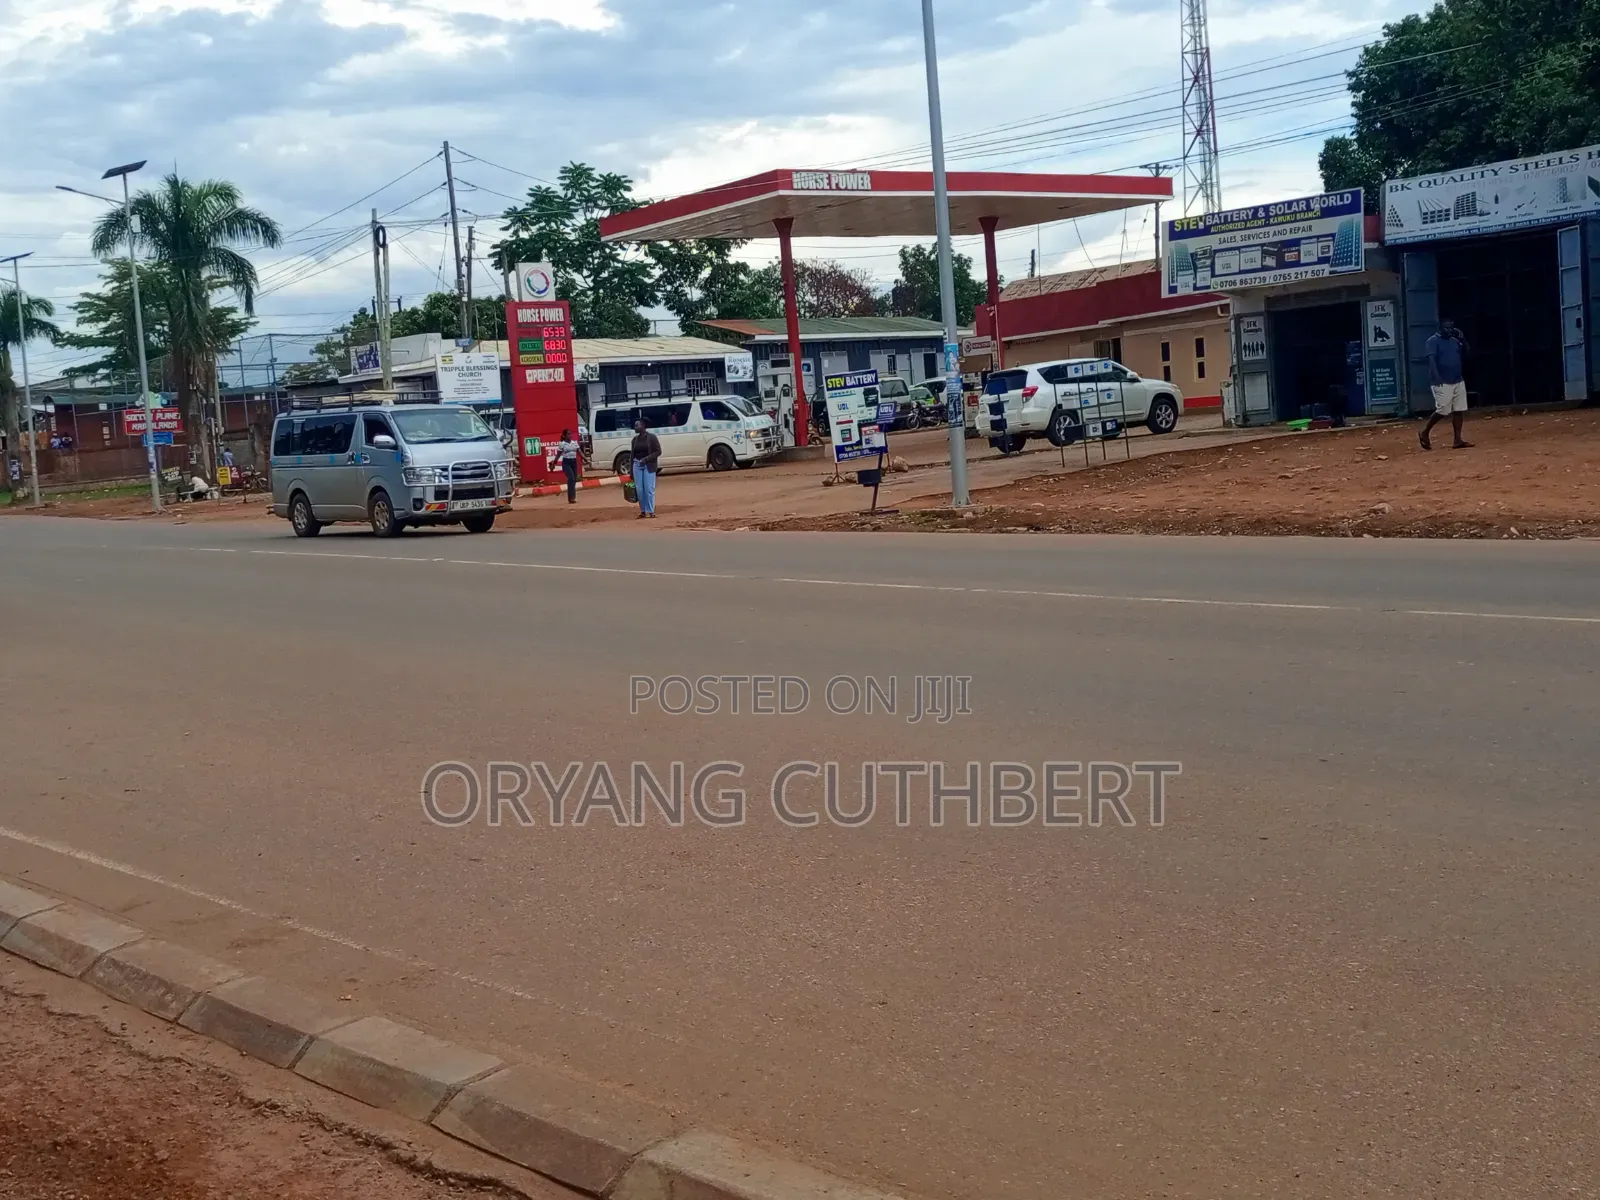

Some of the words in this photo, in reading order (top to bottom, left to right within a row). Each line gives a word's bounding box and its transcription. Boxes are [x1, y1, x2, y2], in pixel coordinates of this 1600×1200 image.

[792, 172, 830, 189] HORSE
[830, 172, 872, 190] POWER
[1389, 182, 1412, 193] BK
[1418, 167, 1503, 189] QUALITY
[1509, 153, 1580, 174] STEELS
[1206, 208, 1254, 226] BATTERY
[1258, 208, 1266, 218] &
[1269, 201, 1306, 216] SOLAR
[1310, 194, 1352, 210] WORLD
[1210, 222, 1246, 233] AUTHORIZED
[1246, 219, 1265, 228] AGENT
[1270, 215, 1295, 224] KAWUKU
[1296, 210, 1320, 220] BRANCH
[1218, 236, 1239, 245] SALES,
[1240, 230, 1270, 242] SERVICES
[1272, 228, 1288, 238] AND
[1290, 224, 1313, 235] REPAIR
[1219, 279, 1238, 288] 0706
[1239, 276, 1267, 286] 863739
[1273, 273, 1292, 282] 0765
[1294, 271, 1308, 279] 217
[1311, 268, 1325, 277] 507
[517, 308, 540, 322] HORSE
[540, 308, 564, 322] POWER
[827, 376, 845, 388] STEV
[846, 373, 876, 385] BATTERY
